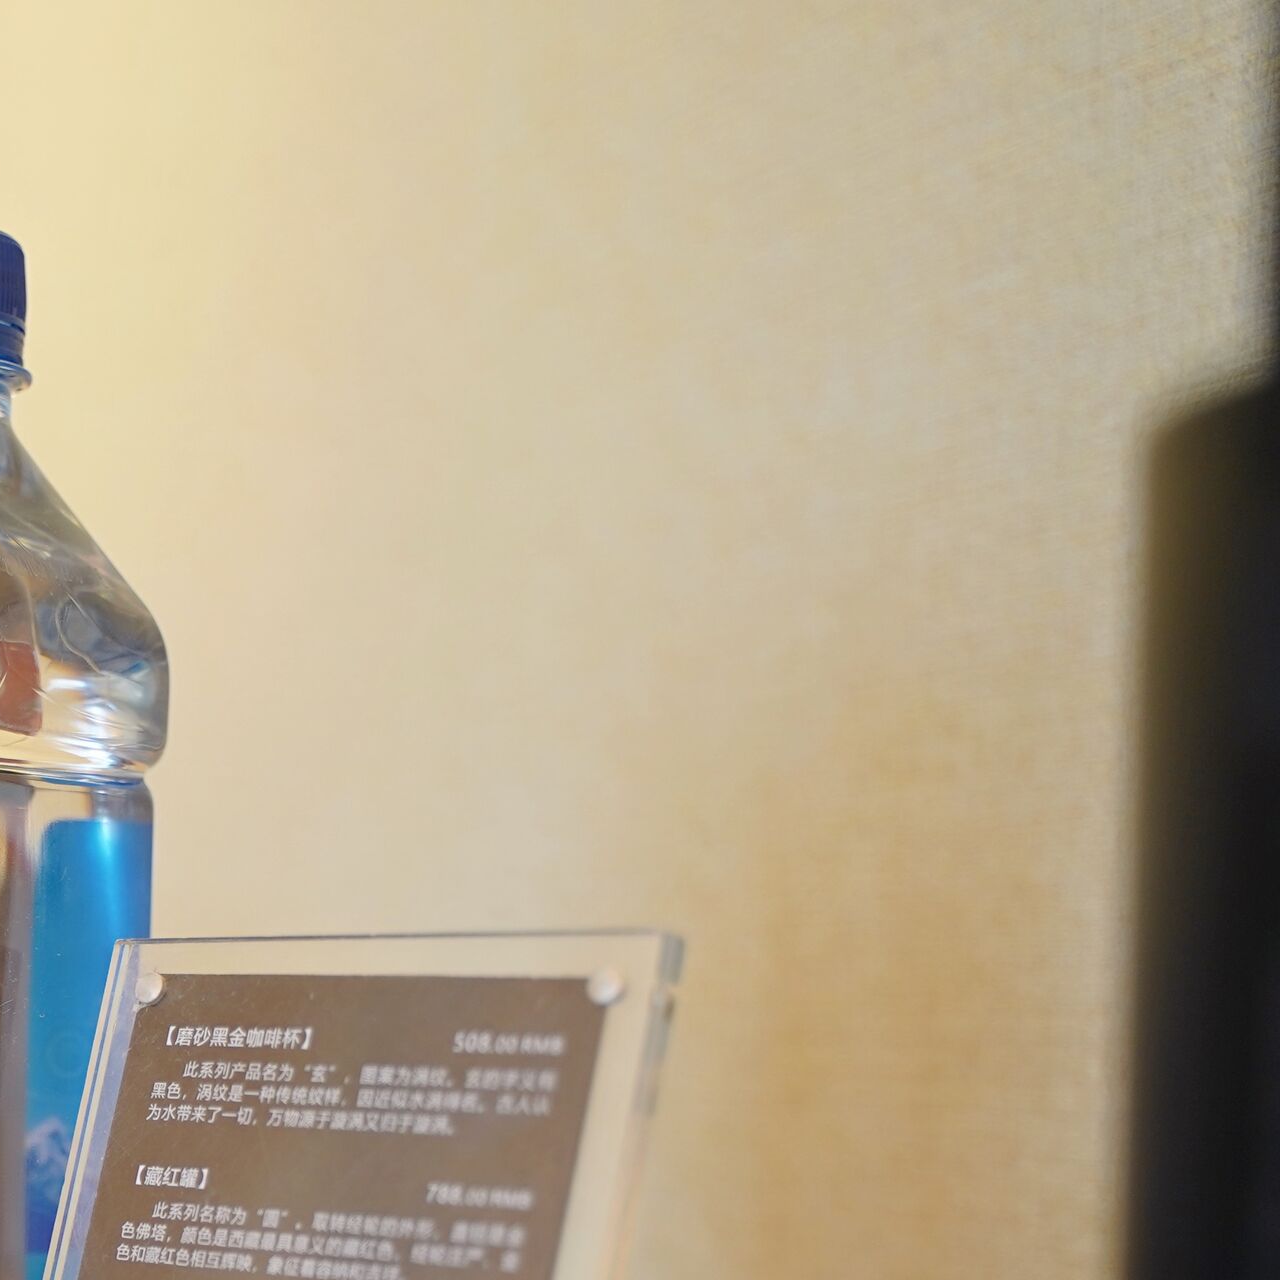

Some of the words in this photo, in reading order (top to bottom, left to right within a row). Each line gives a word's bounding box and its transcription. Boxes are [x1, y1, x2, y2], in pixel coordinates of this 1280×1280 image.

[165, 1024, 314, 1050] 【磨砂黑金咖啡杯】
[135, 1165, 209, 1190] 【藏红罐】
